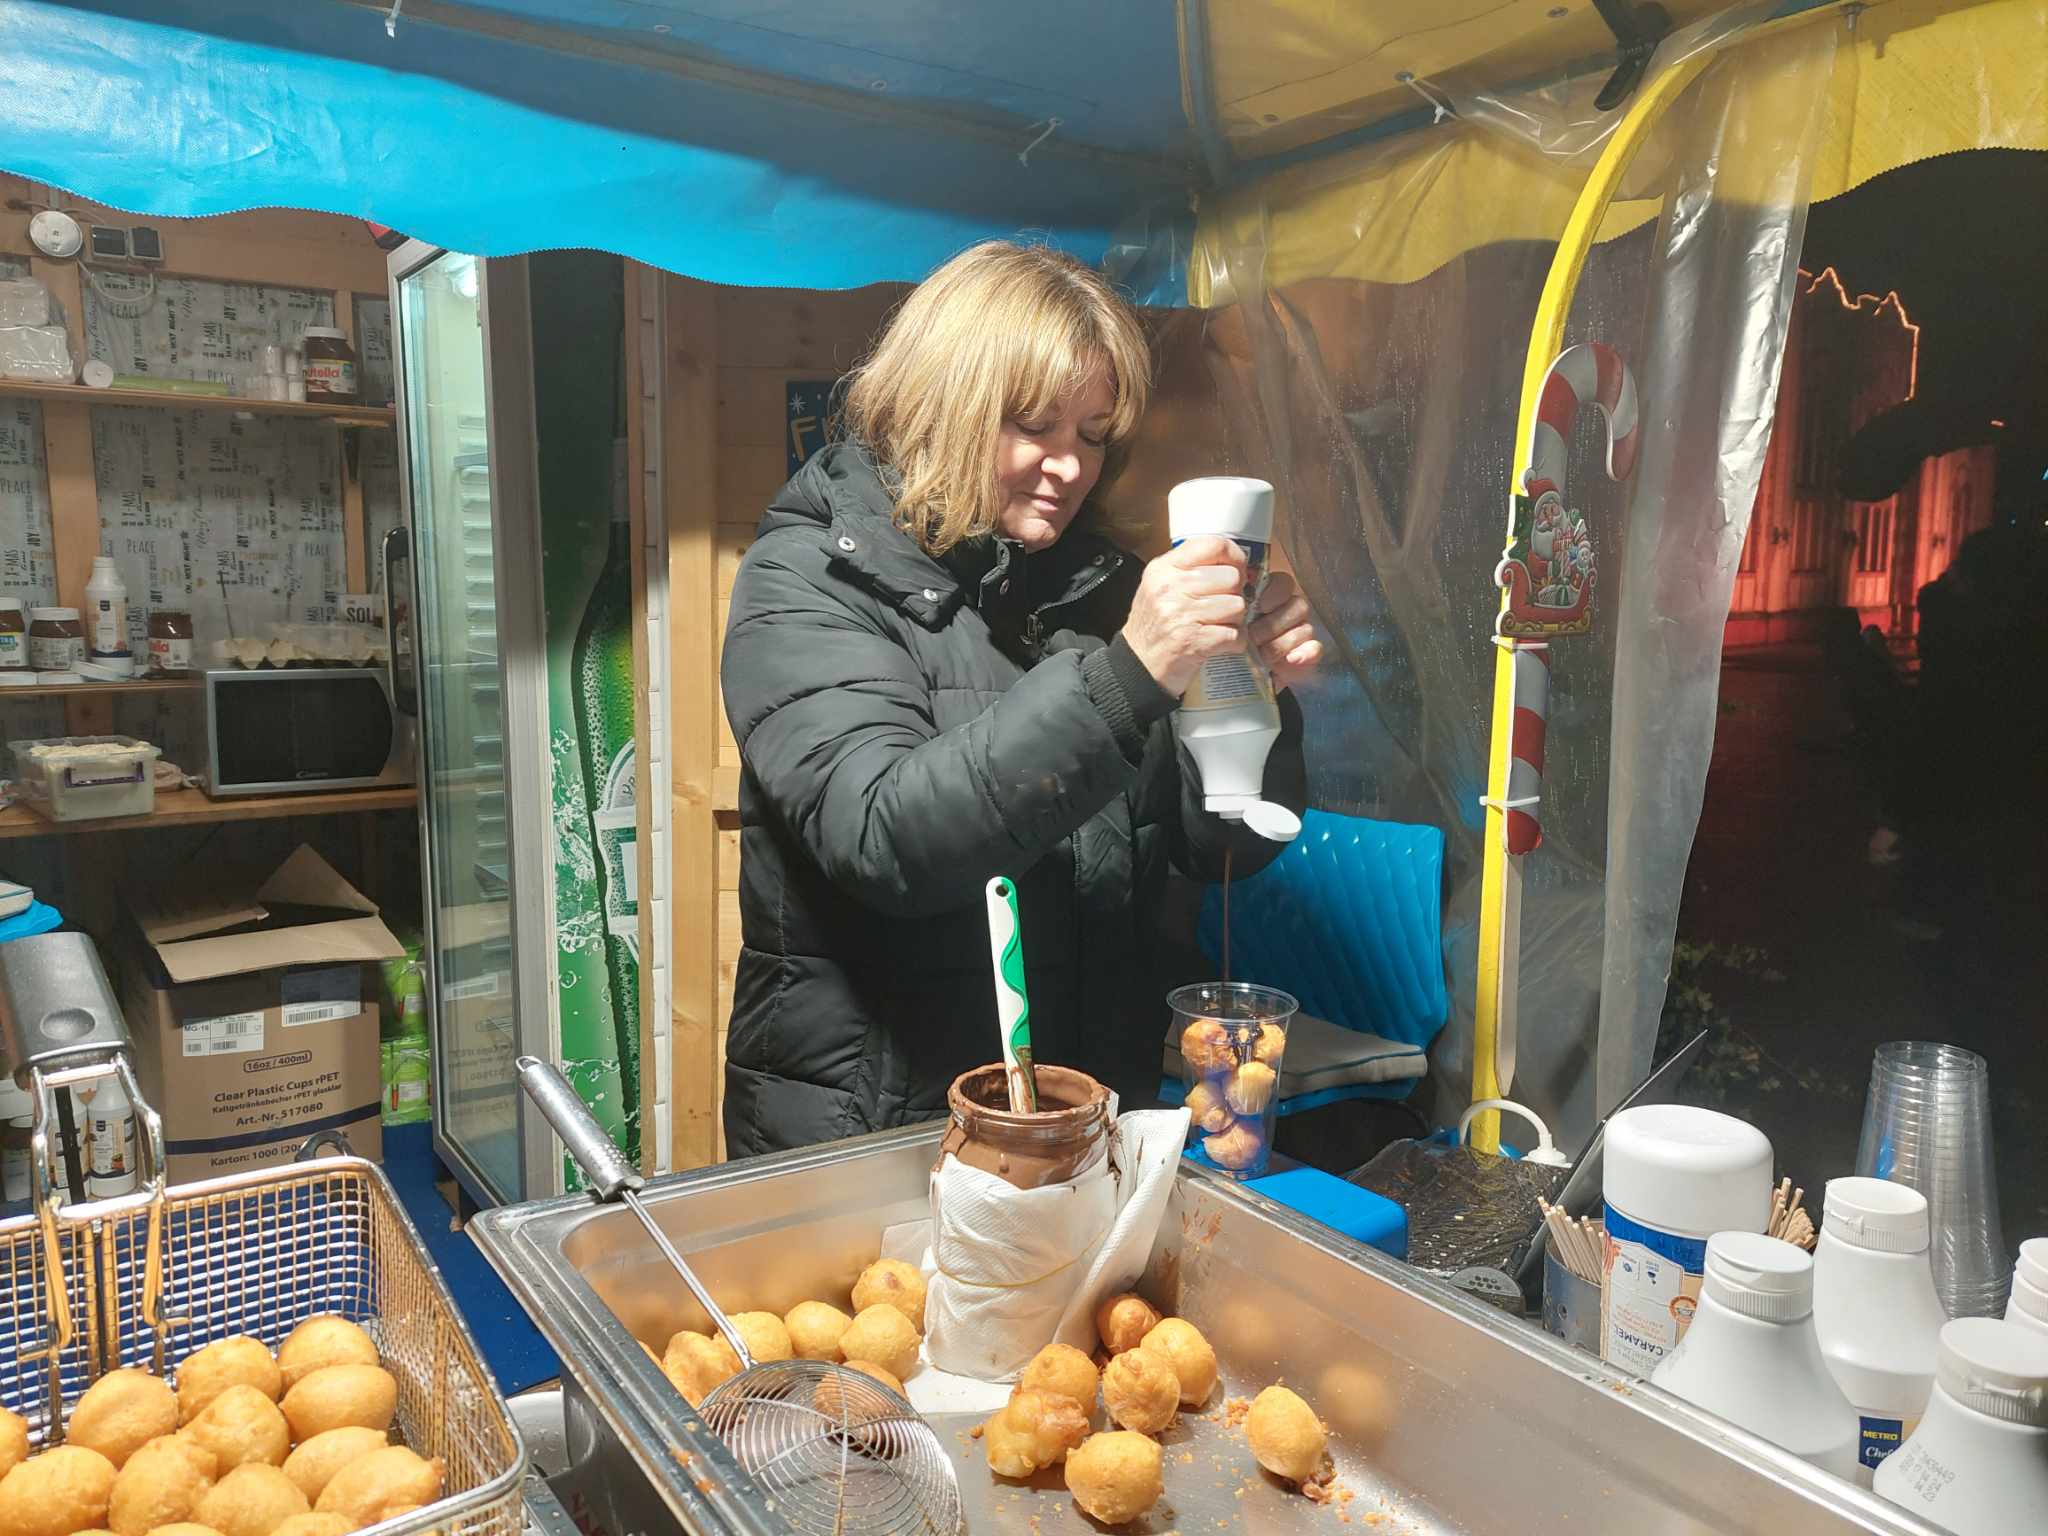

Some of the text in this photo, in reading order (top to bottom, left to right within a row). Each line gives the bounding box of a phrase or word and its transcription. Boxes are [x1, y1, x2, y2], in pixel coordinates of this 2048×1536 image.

[27, 532, 41, 548] JOY
[126, 538, 156, 555] PEACE
[237, 534, 249, 548] JOY
[150, 590, 163, 604] JOY
[247, 1061, 270, 1072] 16oz
[278, 1053, 309, 1065] 400ml
[214, 1071, 341, 1103] Clear Plastic Cups rPET
[212, 1083, 343, 1114] Kaltgetränkebecher rPET glasklar
[236, 1102, 324, 1127] Art.-Nr. 517080
[210, 1151, 250, 1167] Karton:
[252, 1147, 279, 1160] 1000
[1614, 1325, 1664, 1356] CARAMEL
[1862, 1430, 1898, 1441] METRO
